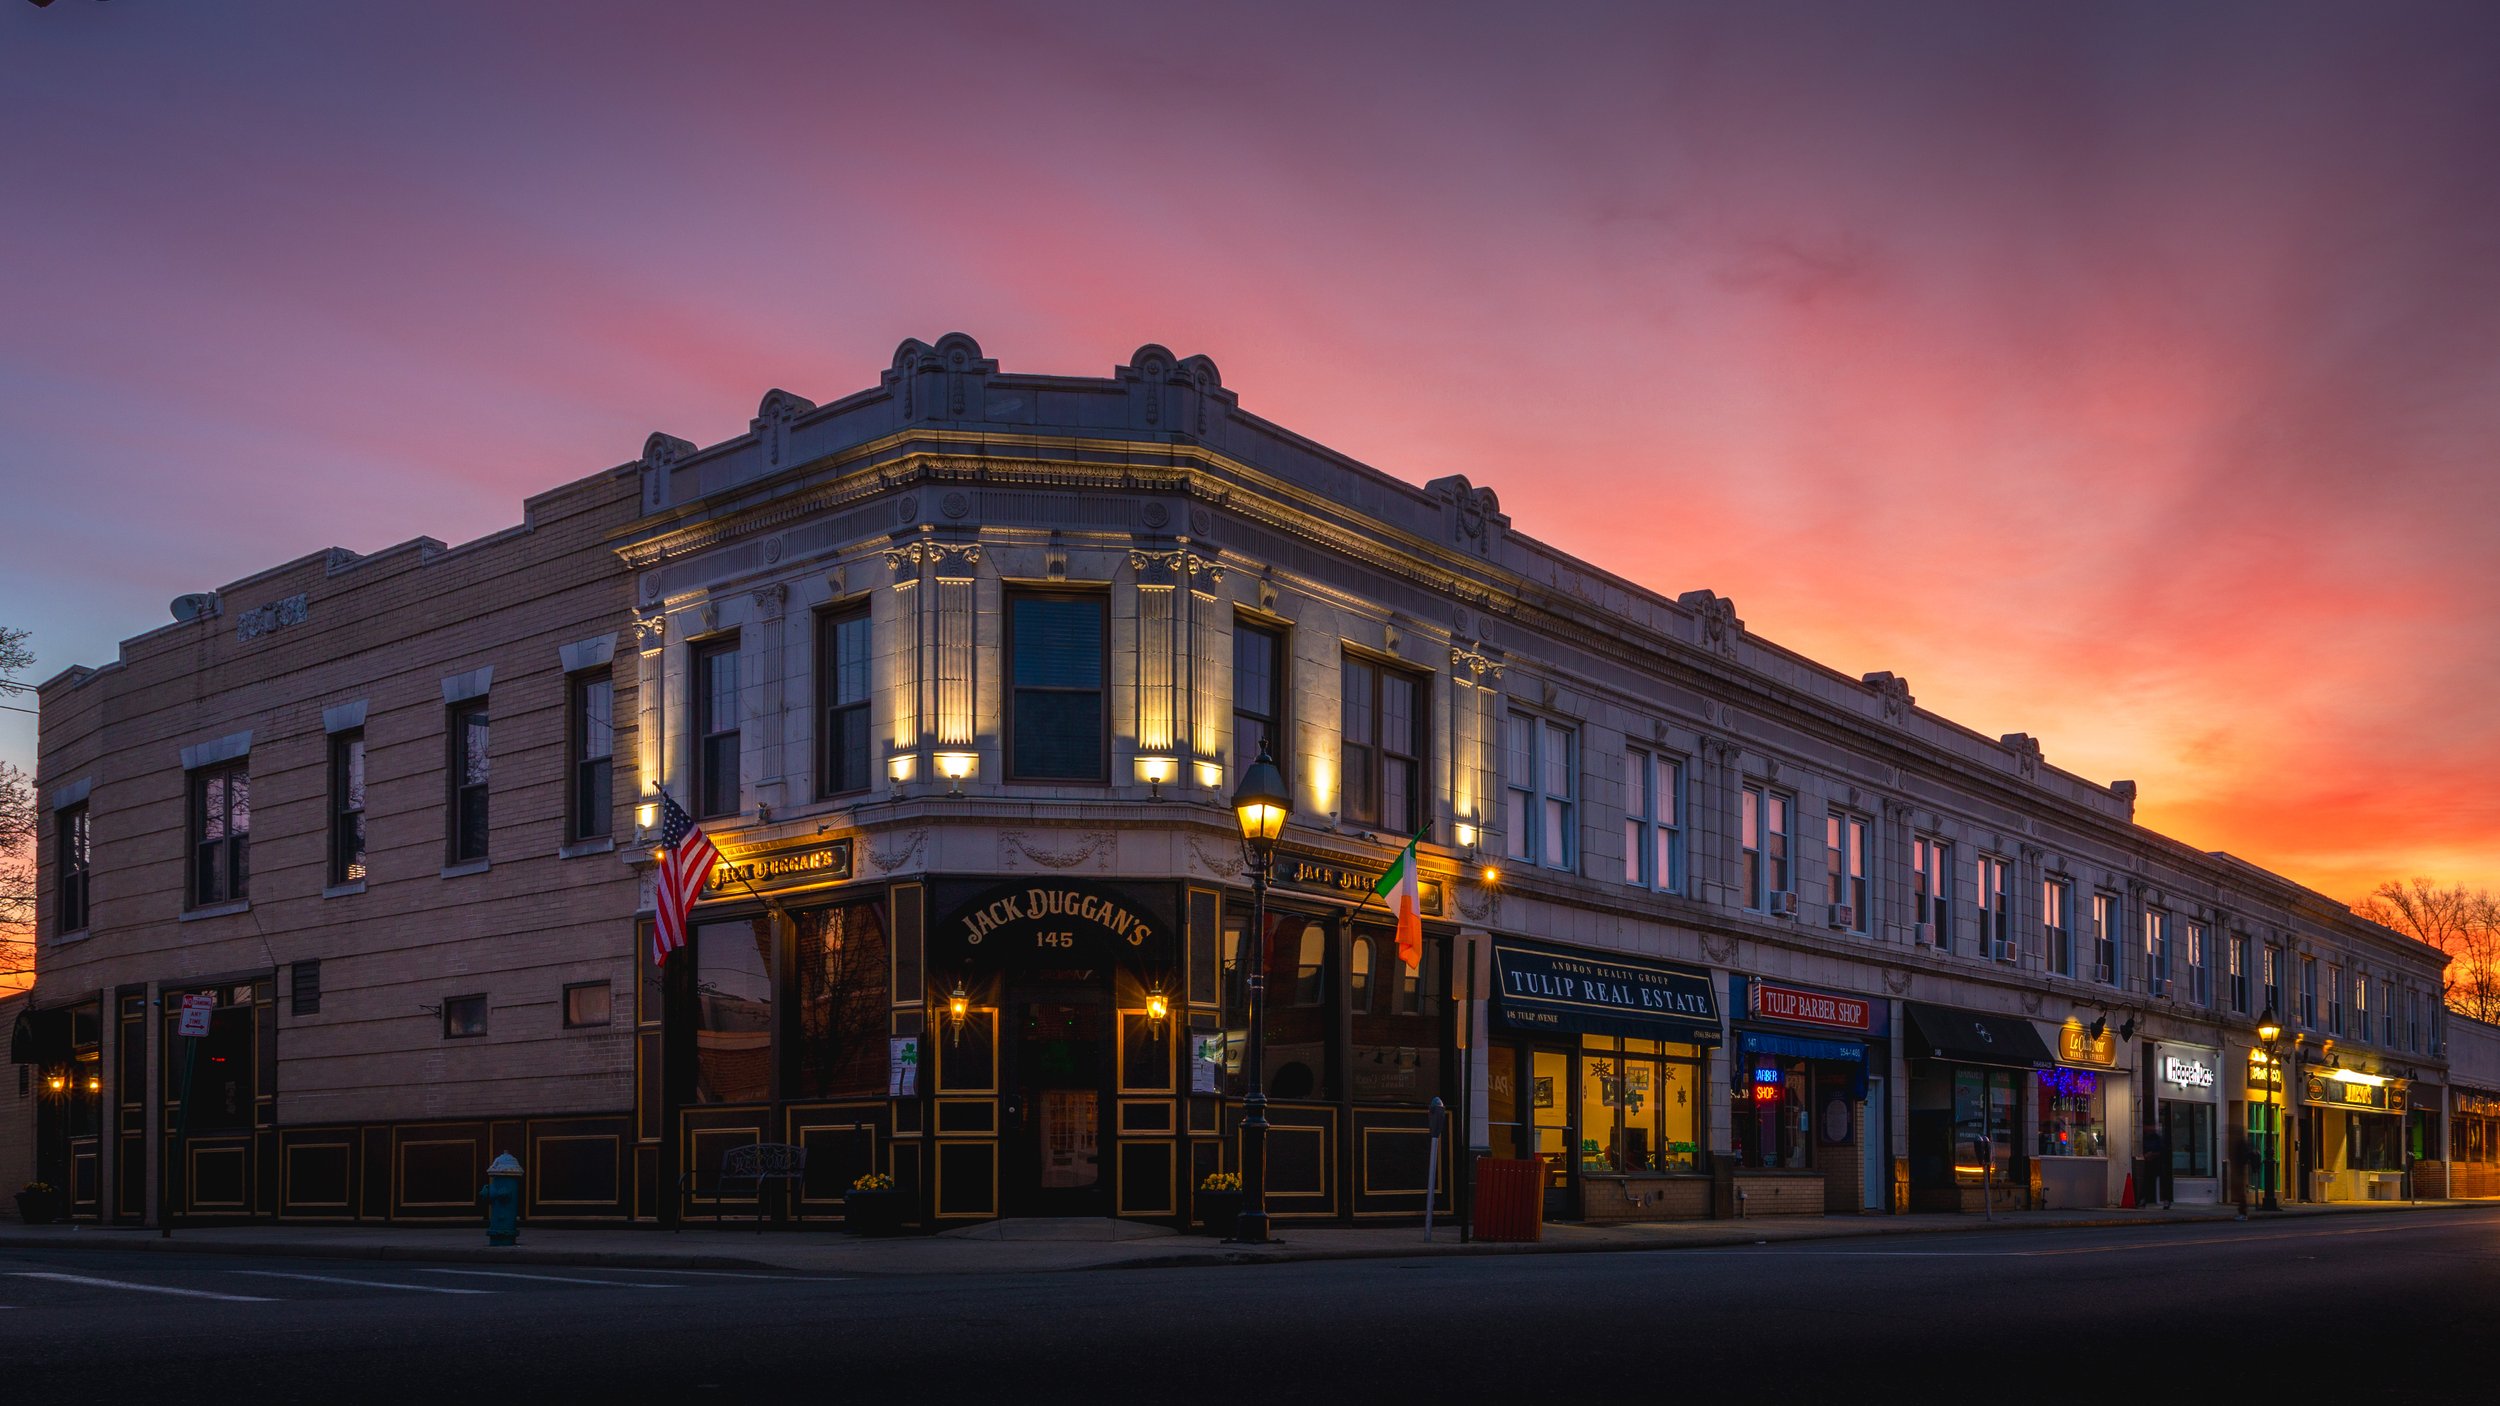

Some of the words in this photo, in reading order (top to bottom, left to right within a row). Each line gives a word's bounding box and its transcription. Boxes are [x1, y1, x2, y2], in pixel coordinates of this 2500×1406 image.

[711, 863, 755, 889] JACK
[757, 850, 834, 879] DUGGAN'S
[1294, 862, 1333, 882] JACK
[962, 895, 1024, 945] JACK
[1026, 888, 1152, 946] DUGGAN'S
[1036, 931, 1073, 948] 145
[1552, 961, 1592, 975] ANDRON
[1597, 968, 1634, 981] REALTY
[1639, 974, 1669, 985] GROUP
[1511, 971, 1575, 997] TULIP
[1582, 980, 1635, 1005] REAL
[1640, 988, 1708, 1014] ESTATE
[1517, 1011, 1536, 1021] TULIP
[1537, 1013, 1559, 1023] AVENUE
[1765, 991, 1797, 1015] TULIP
[1798, 996, 1836, 1021] BARBER
[1838, 1002, 1862, 1024] SHOP
[2070, 1034, 2078, 1049] Le
[2070, 1051, 2084, 1059] WINES
[1757, 1086, 1774, 1099] SHOP
